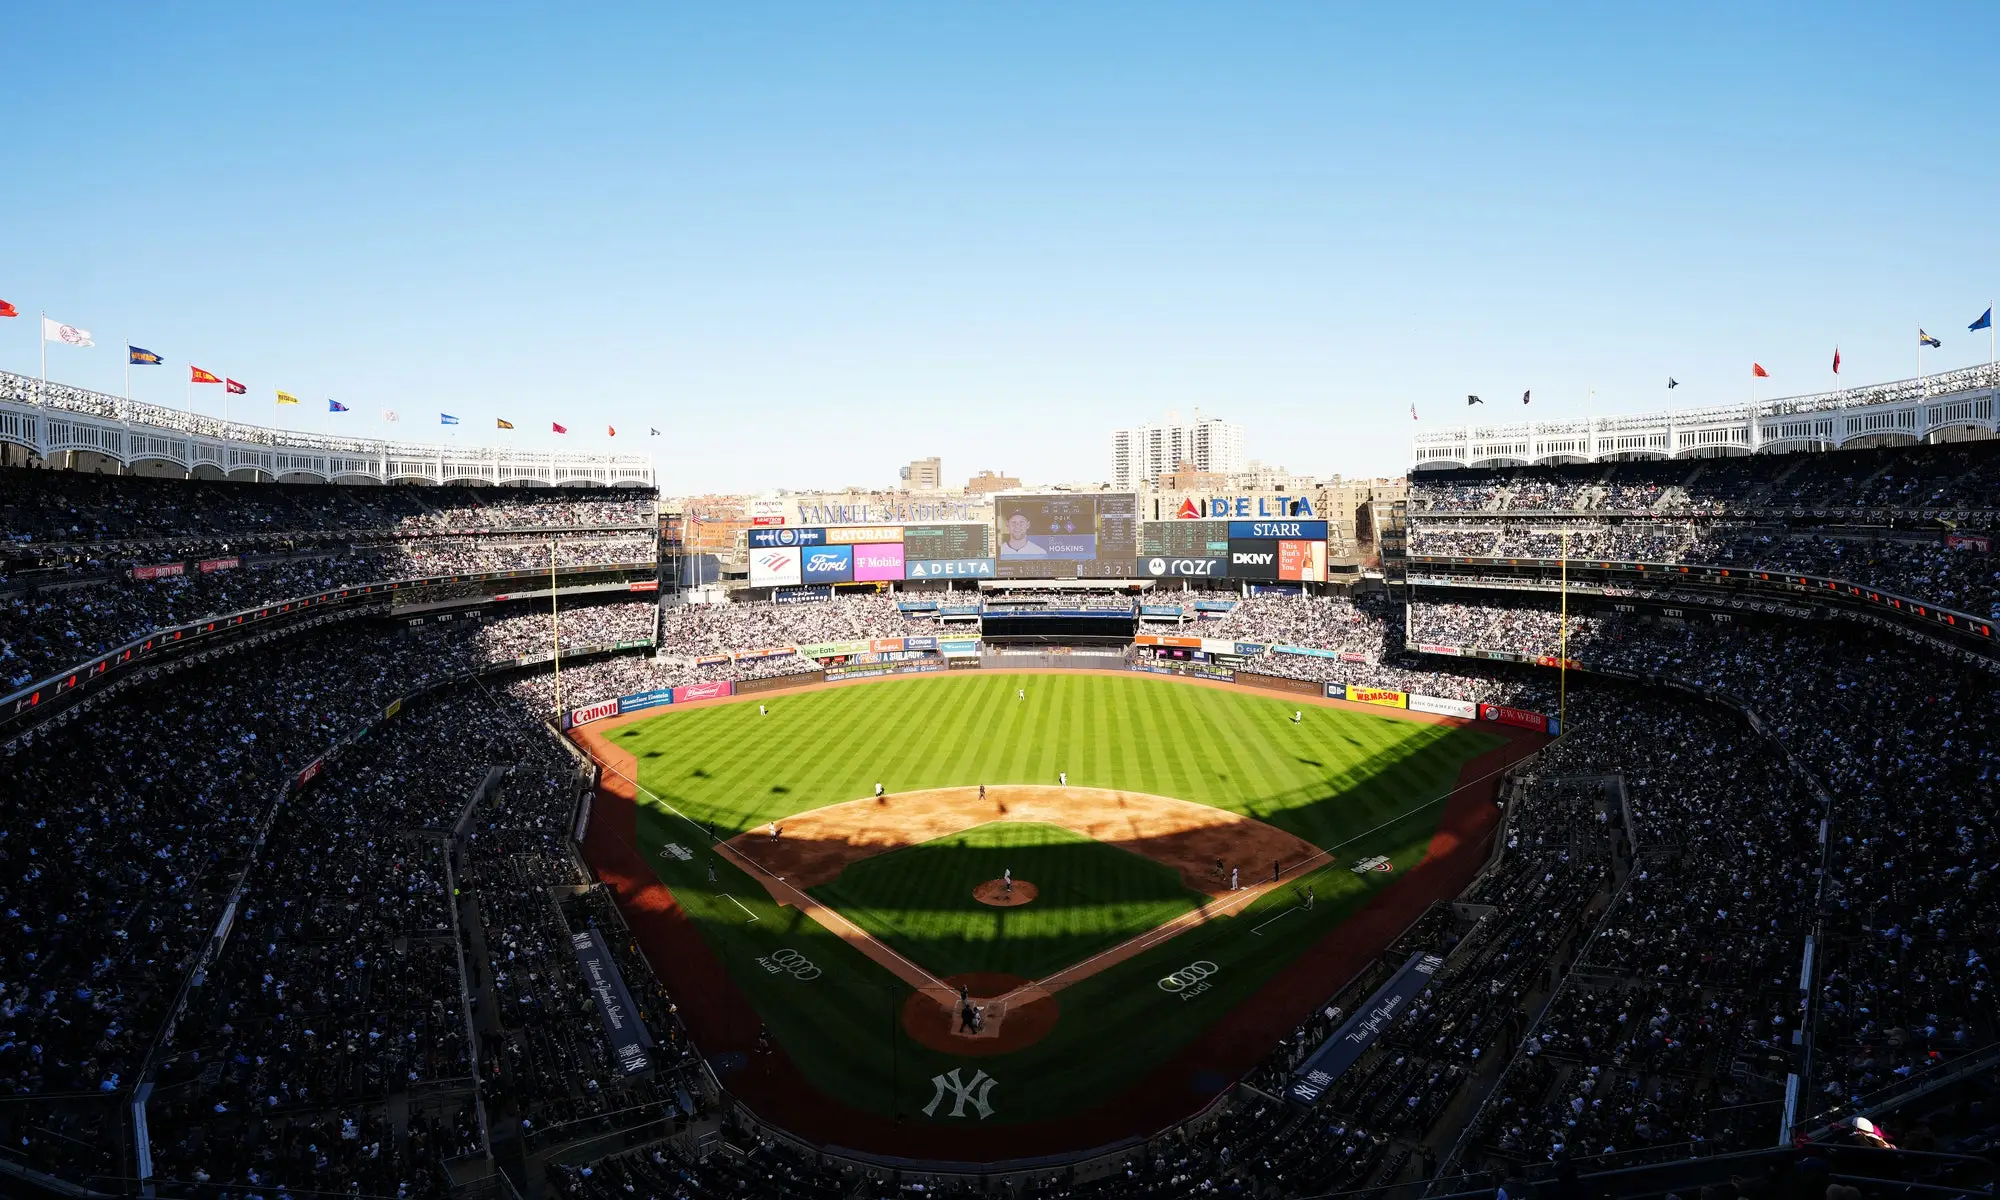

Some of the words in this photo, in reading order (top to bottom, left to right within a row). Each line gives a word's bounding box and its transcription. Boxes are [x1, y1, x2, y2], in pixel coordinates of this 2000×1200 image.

[1211, 496, 1313, 518] DELTA
[798, 503, 872, 524] YANKEE
[884, 503, 968, 522] STADIUM
[830, 529, 900, 541] GATORADE
[1254, 524, 1302, 536] STARR
[807, 554, 848, 572] Ford
[868, 556, 901, 567] Mobile
[1233, 553, 1274, 564] DKNY
[156, 568, 170, 576] PARTY
[171, 566, 184, 575] DECK
[217, 561, 228, 569] PARTY
[932, 562, 989, 574] DELTA
[1104, 566, 1110, 574] 3
[1115, 566, 1121, 574] 2
[1128, 566, 1132, 574] 1
[1172, 560, 1216, 575] razr
[1663, 608, 1683, 617] YETI
[1712, 614, 1732, 622] YETI
[528, 654, 548, 663] ORIS
[1357, 692, 1399, 701] W.B.MASON
[573, 702, 616, 724] Canon
[1517, 711, 1541, 724] WEBB
[755, 956, 783, 976] Audi
[1180, 982, 1212, 1001] Audi
[1346, 1029, 1369, 1043] New
[1360, 1012, 1380, 1033] York
[1377, 995, 1402, 1020] Yankees
[922, 1068, 1000, 1120] NY
